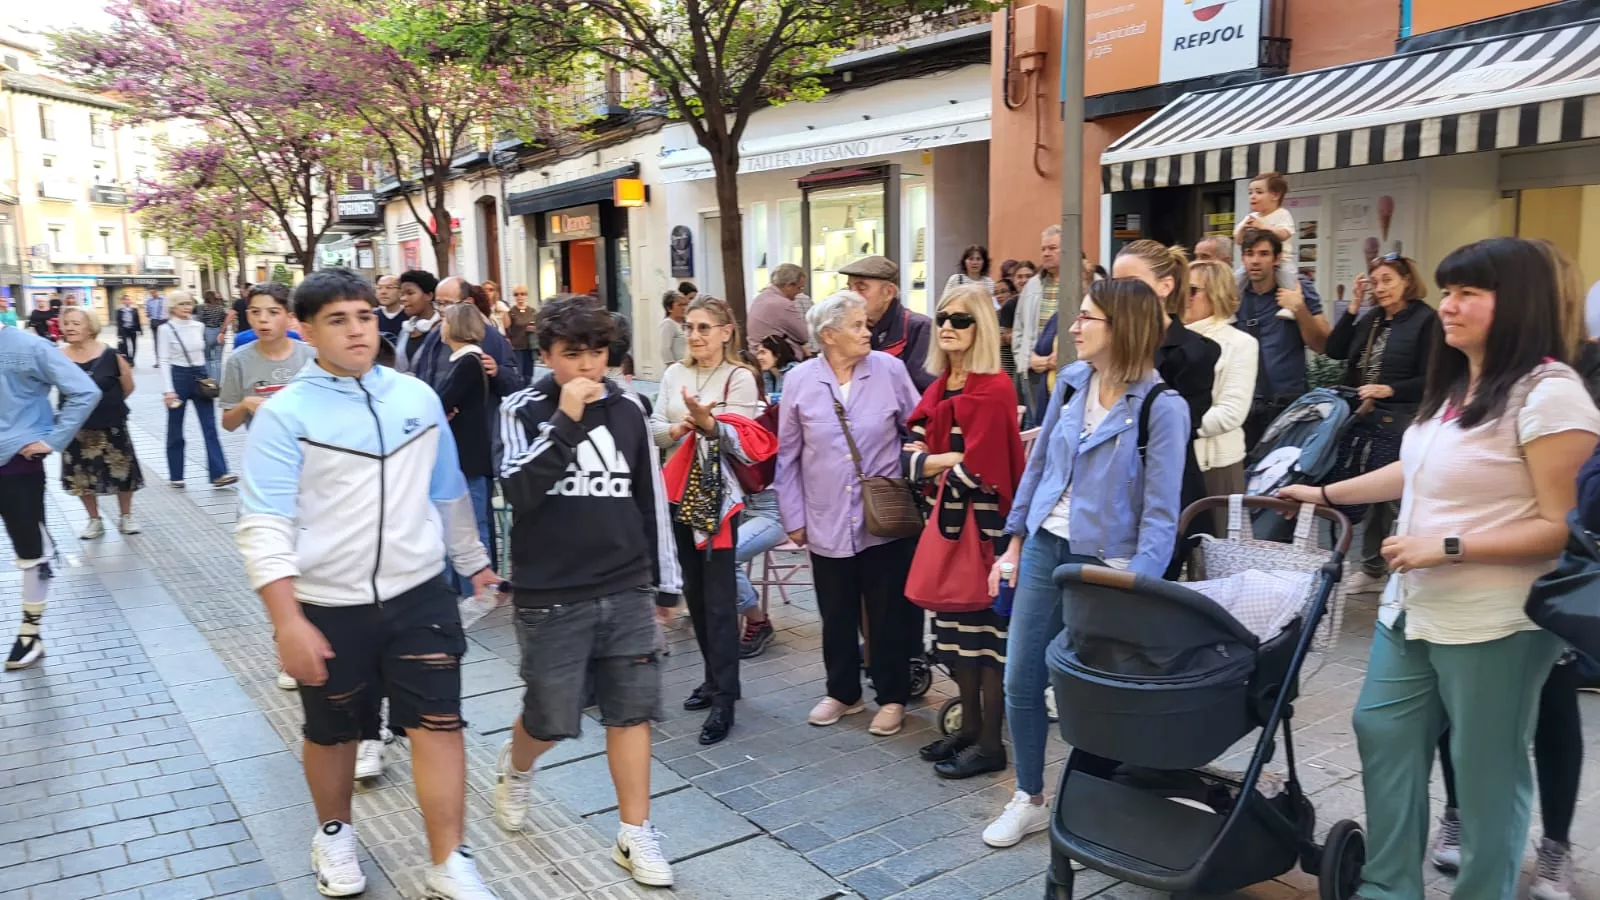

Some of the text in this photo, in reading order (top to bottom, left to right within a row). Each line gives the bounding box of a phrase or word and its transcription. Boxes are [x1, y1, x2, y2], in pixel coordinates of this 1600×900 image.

[1173, 24, 1246, 52] REPSOL
[747, 141, 869, 171] TALLER ARTESANO
